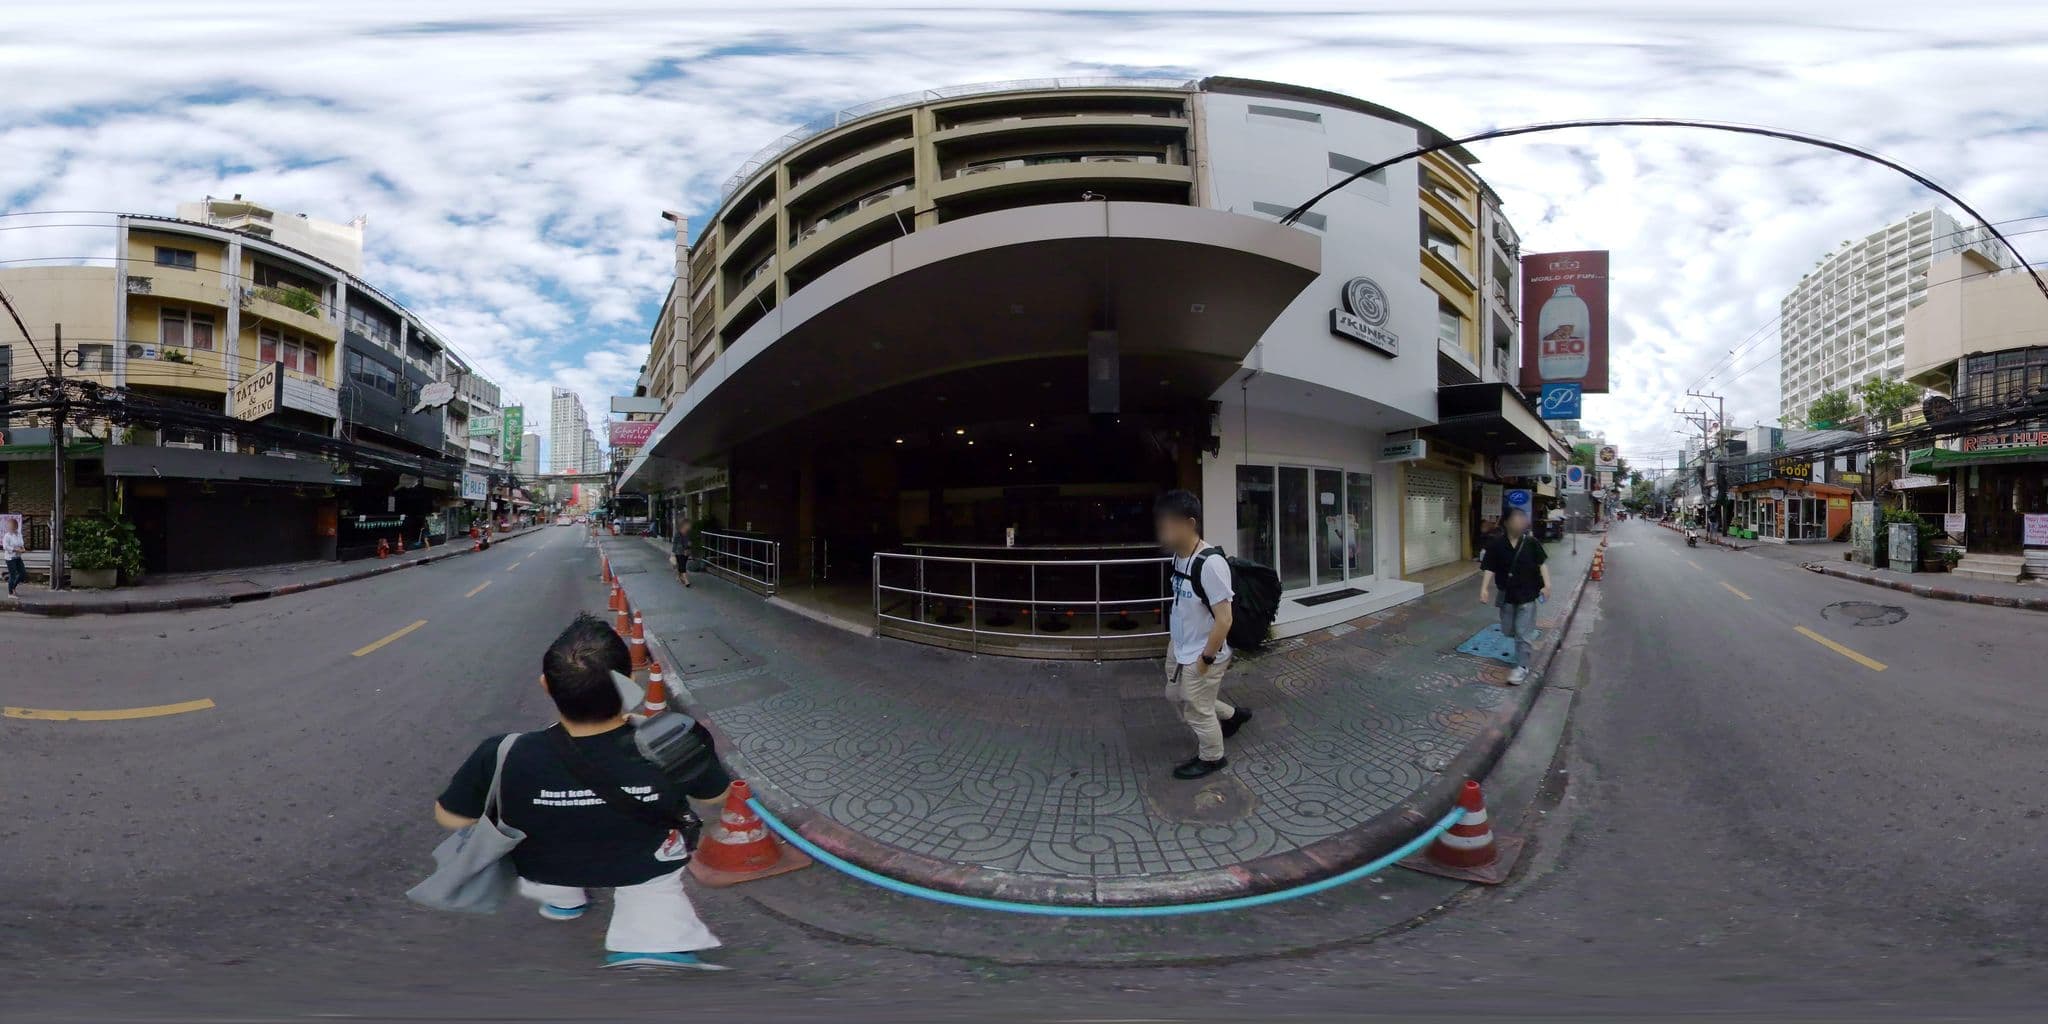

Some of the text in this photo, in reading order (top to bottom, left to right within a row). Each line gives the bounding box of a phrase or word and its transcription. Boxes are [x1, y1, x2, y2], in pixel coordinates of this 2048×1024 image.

[1530, 275, 1561, 283] WORLD
[1340, 316, 1396, 348] SKUNKZ
[1543, 340, 1585, 354] LEO
[236, 371, 273, 402] TATTOO
[238, 399, 273, 420] IERCING
[1964, 434, 2008, 452] REST
[1780, 466, 1808, 477] FOOD
